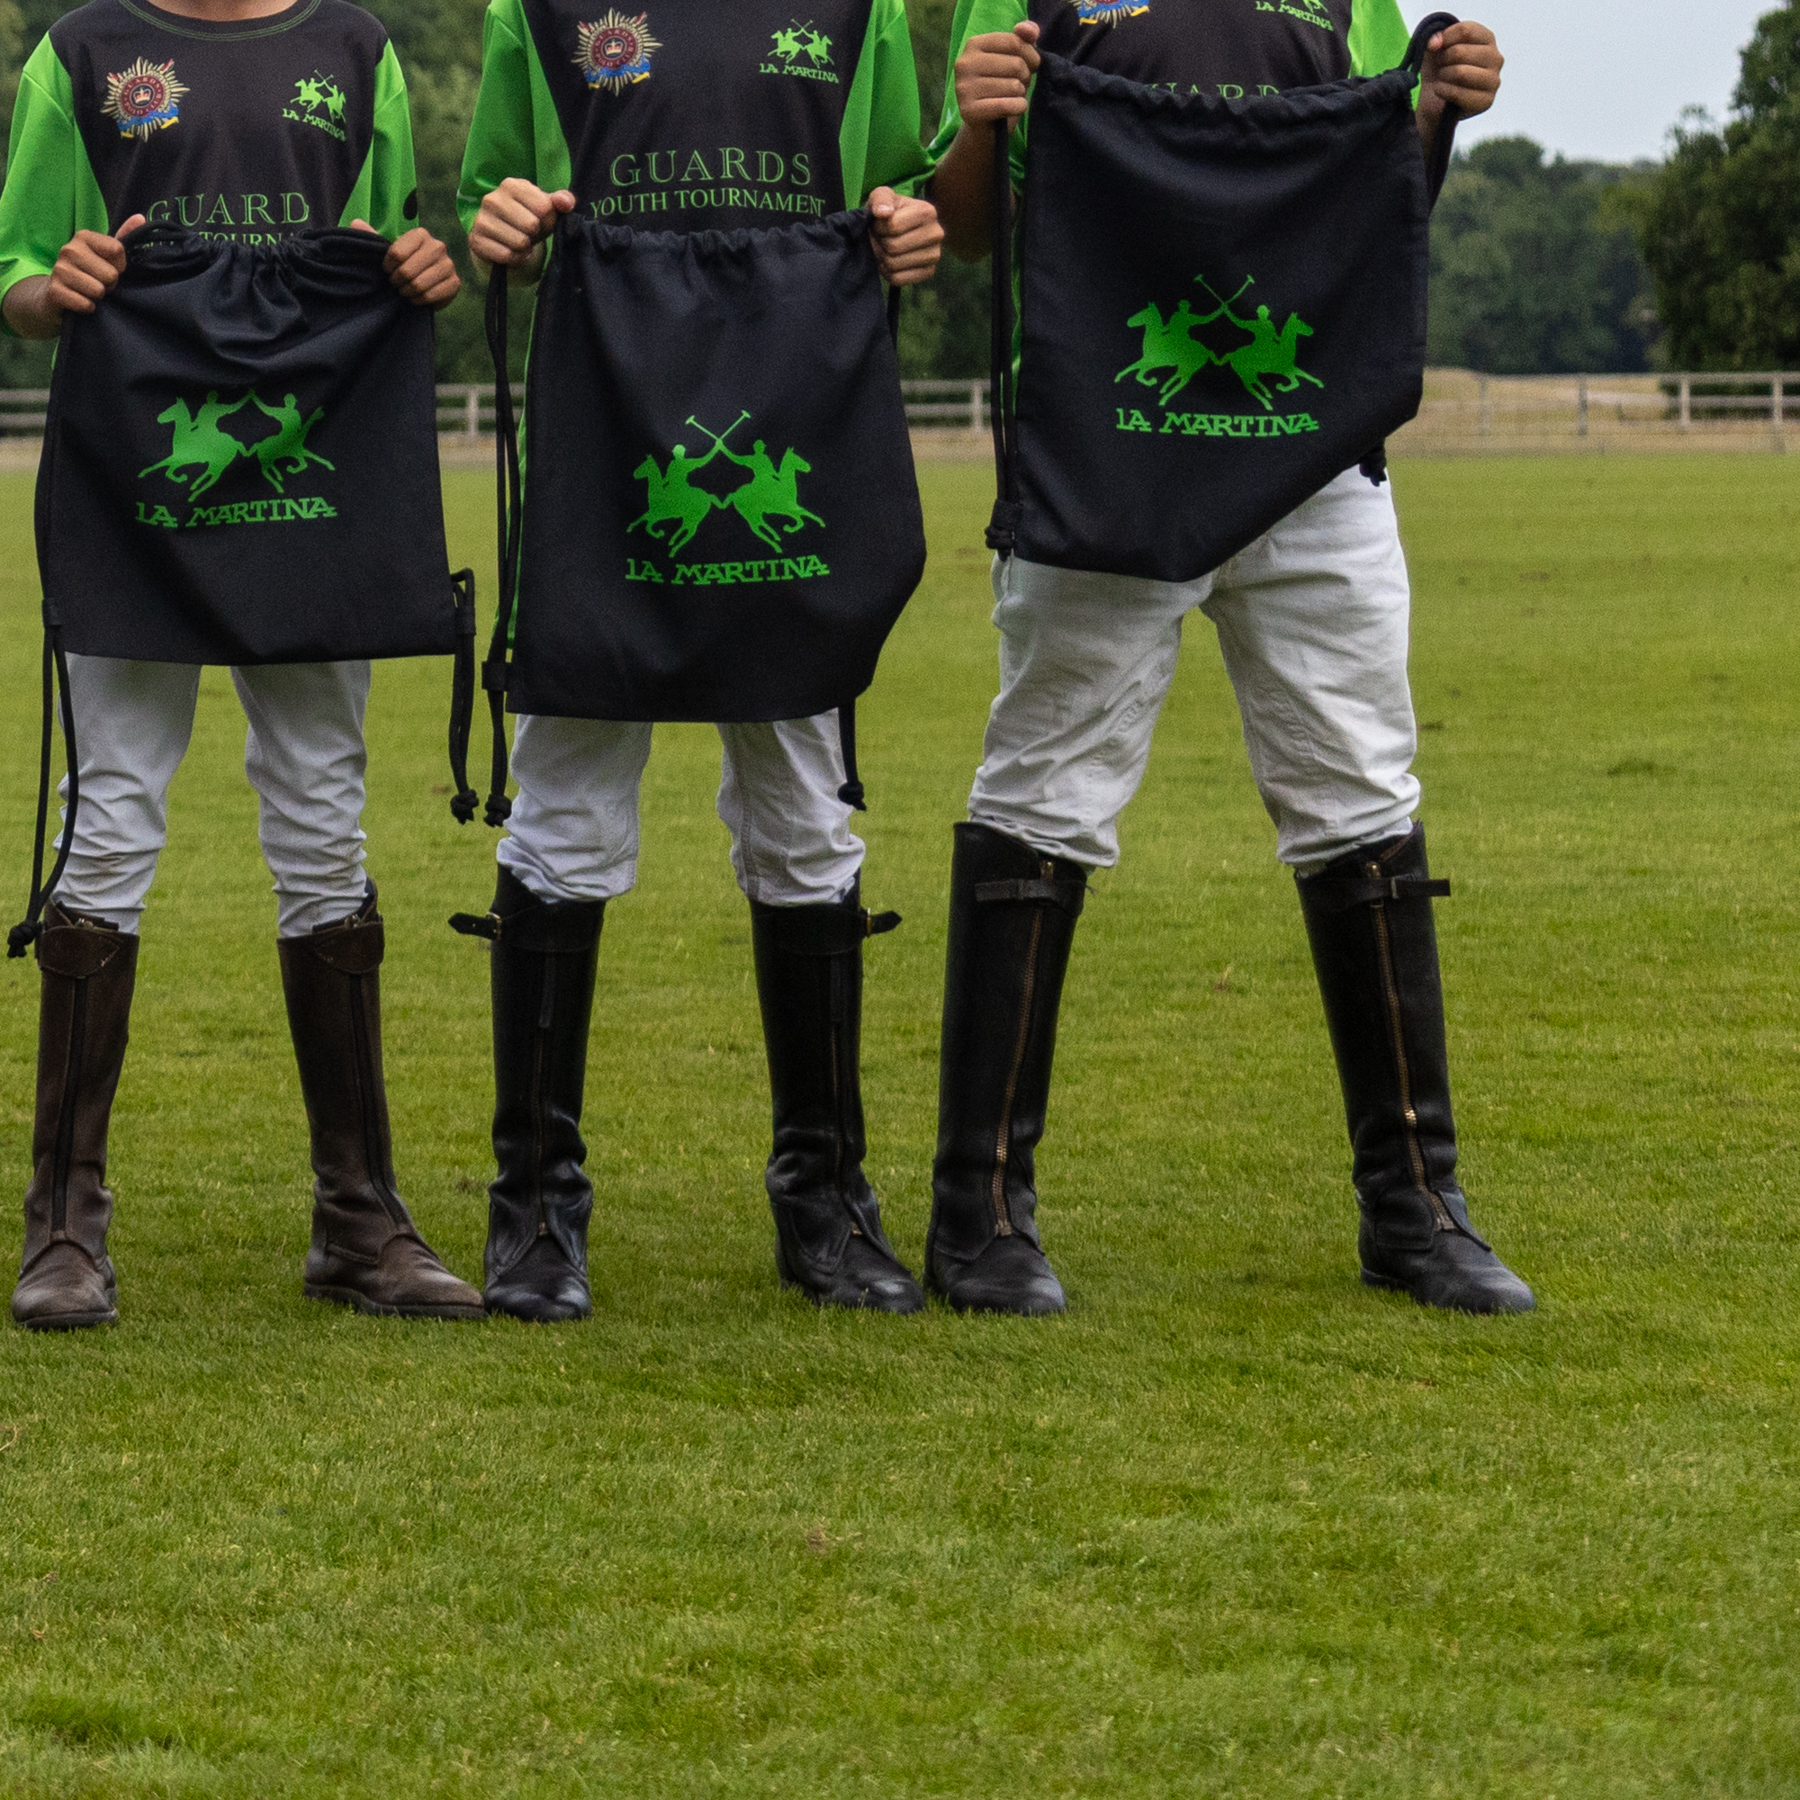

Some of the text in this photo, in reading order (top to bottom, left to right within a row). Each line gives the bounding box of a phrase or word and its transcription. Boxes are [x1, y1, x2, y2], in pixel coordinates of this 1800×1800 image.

[1256, 1, 1275, 12] LA
[759, 63, 839, 84] LA MARTINA
[282, 108, 300, 121] LA
[610, 147, 811, 187] GUARDS
[147, 192, 310, 227] GUARD
[590, 188, 826, 219] YOUTH TOURNAMENT
[1116, 408, 1319, 437] LA MARTINA
[135, 497, 338, 528] LA MARTINA
[625, 554, 830, 585] LA MARTINA
